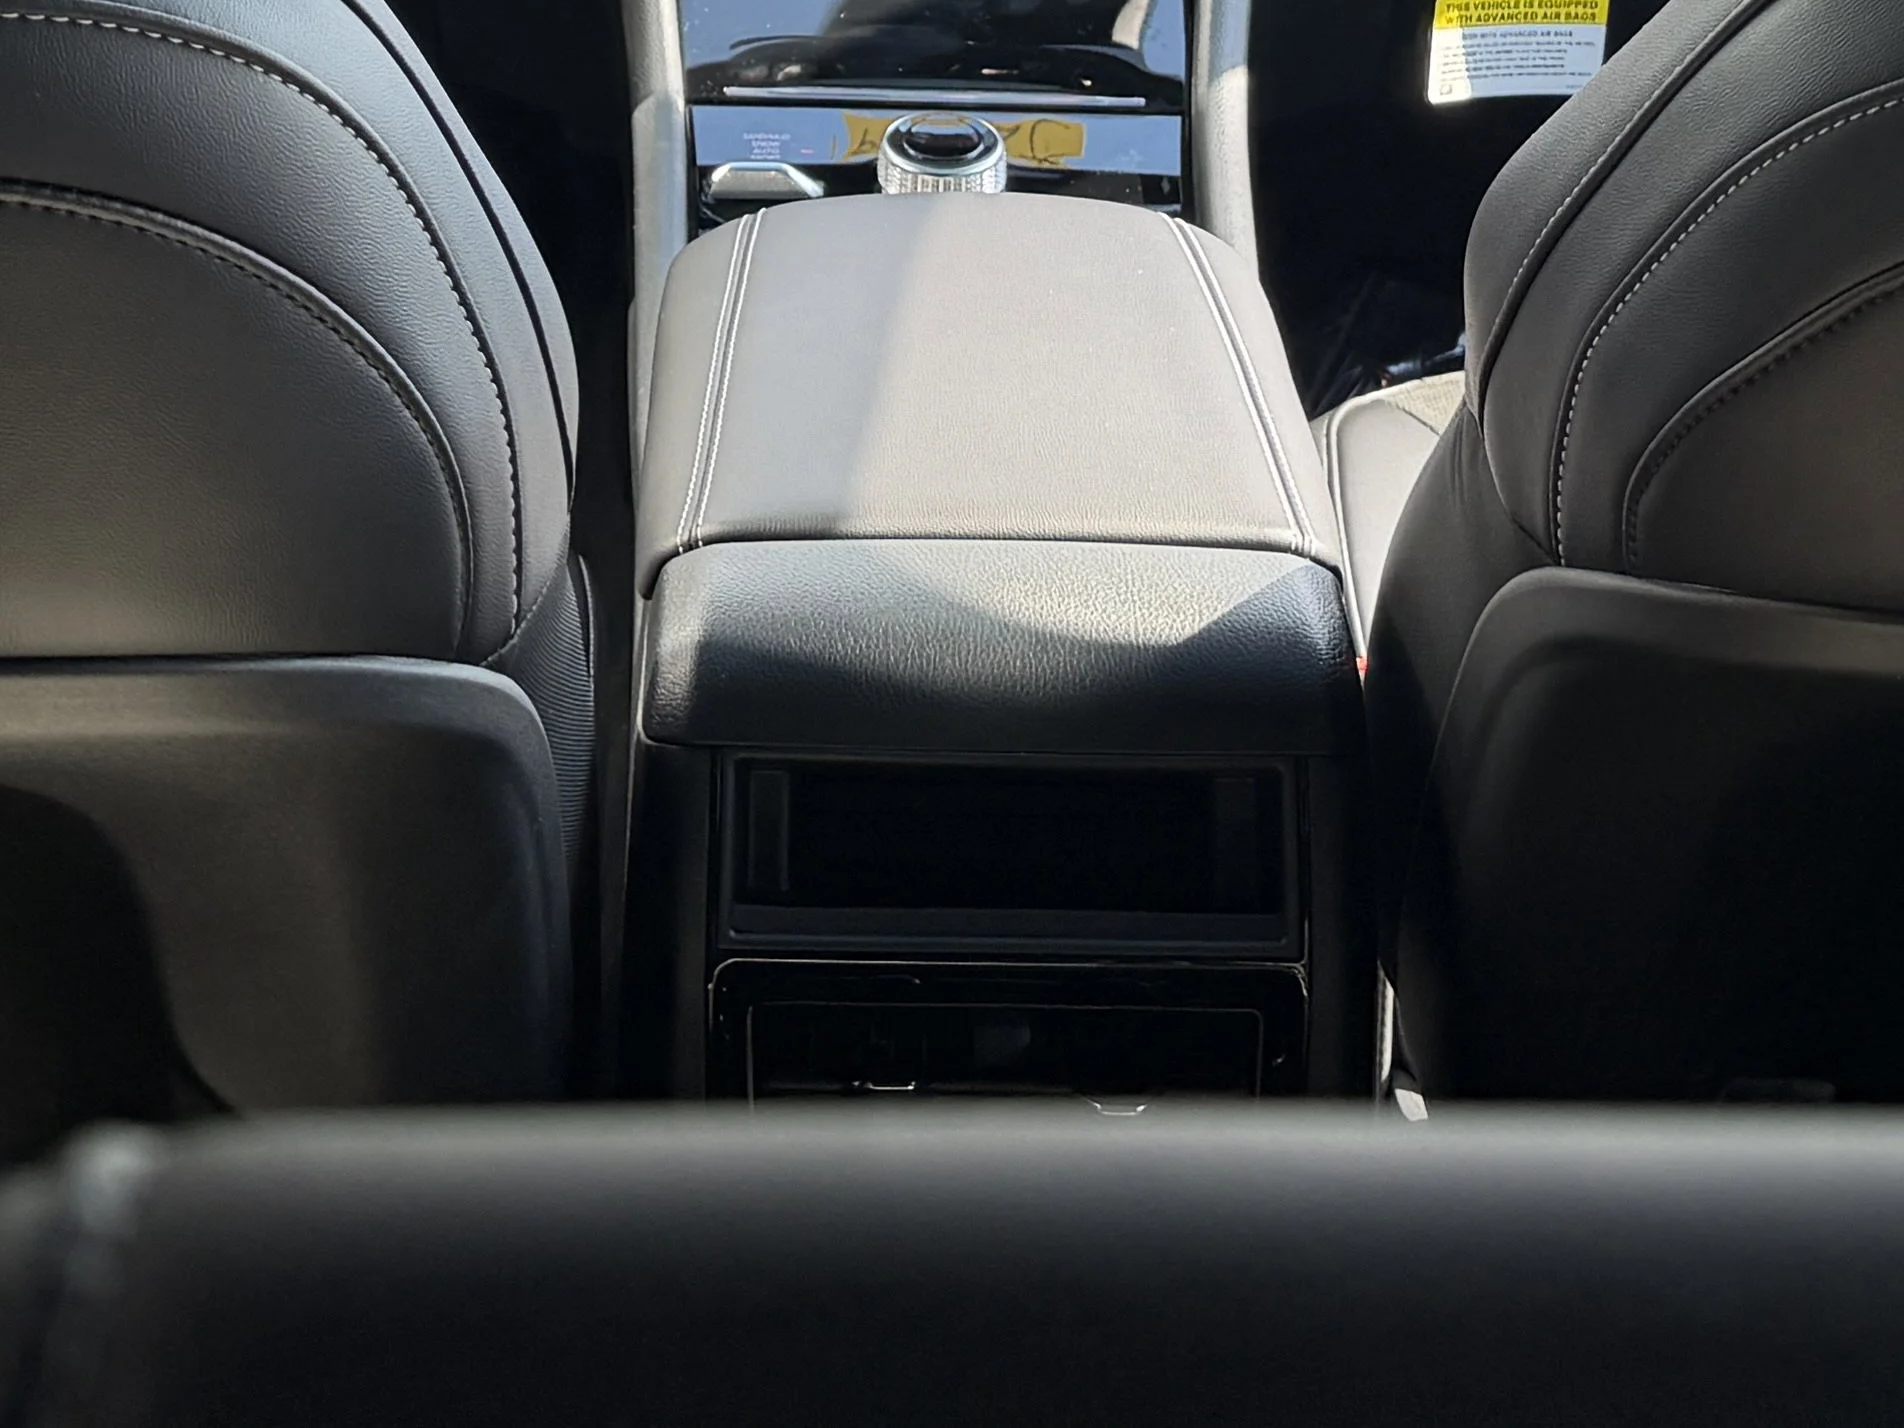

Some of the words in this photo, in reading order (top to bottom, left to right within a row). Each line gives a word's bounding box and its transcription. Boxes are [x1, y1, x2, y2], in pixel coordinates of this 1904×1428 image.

[1446, 2, 1471, 13] THIS
[1472, 0, 1521, 10] VEHICLE
[1444, 12, 1473, 24] WITH
[1474, 10, 1539, 23] ADVANCED
[1540, 10, 1562, 21] AIR
[1563, 10, 1597, 22] BAGS
